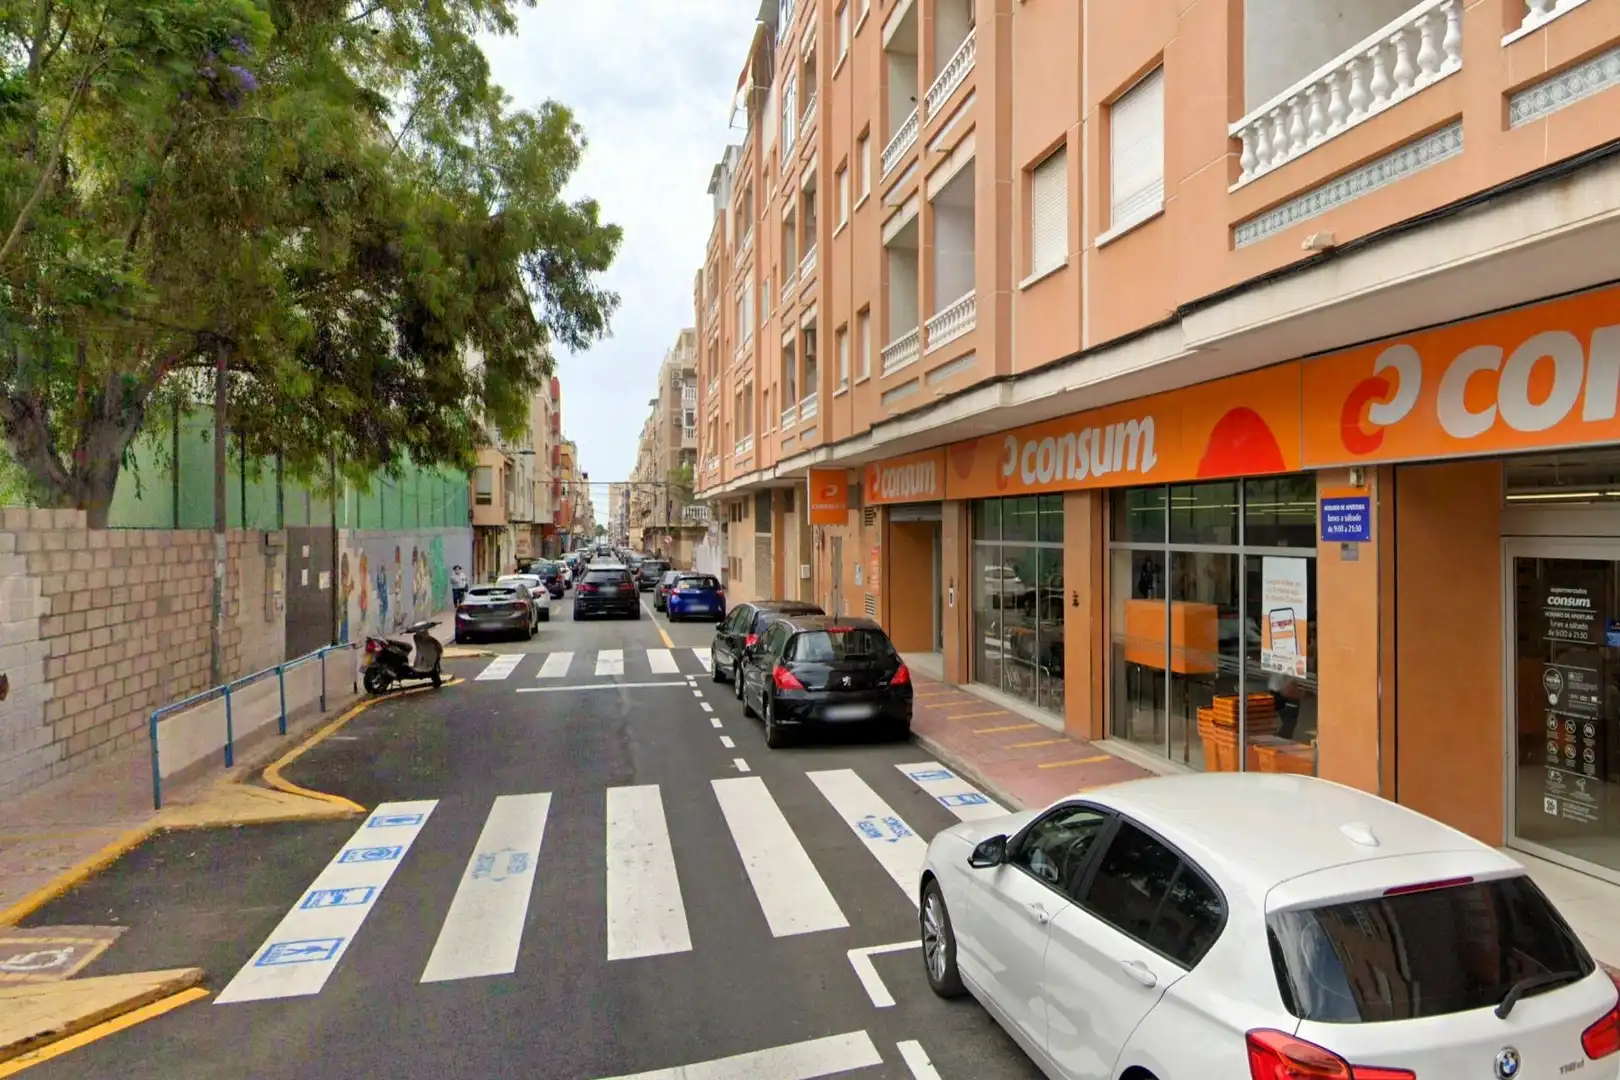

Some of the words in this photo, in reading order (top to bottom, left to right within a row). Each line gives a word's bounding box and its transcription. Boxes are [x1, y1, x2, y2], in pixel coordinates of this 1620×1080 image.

[1020, 416, 1157, 485] consum
[881, 460, 936, 498] consum
[1547, 596, 1591, 608] consum
